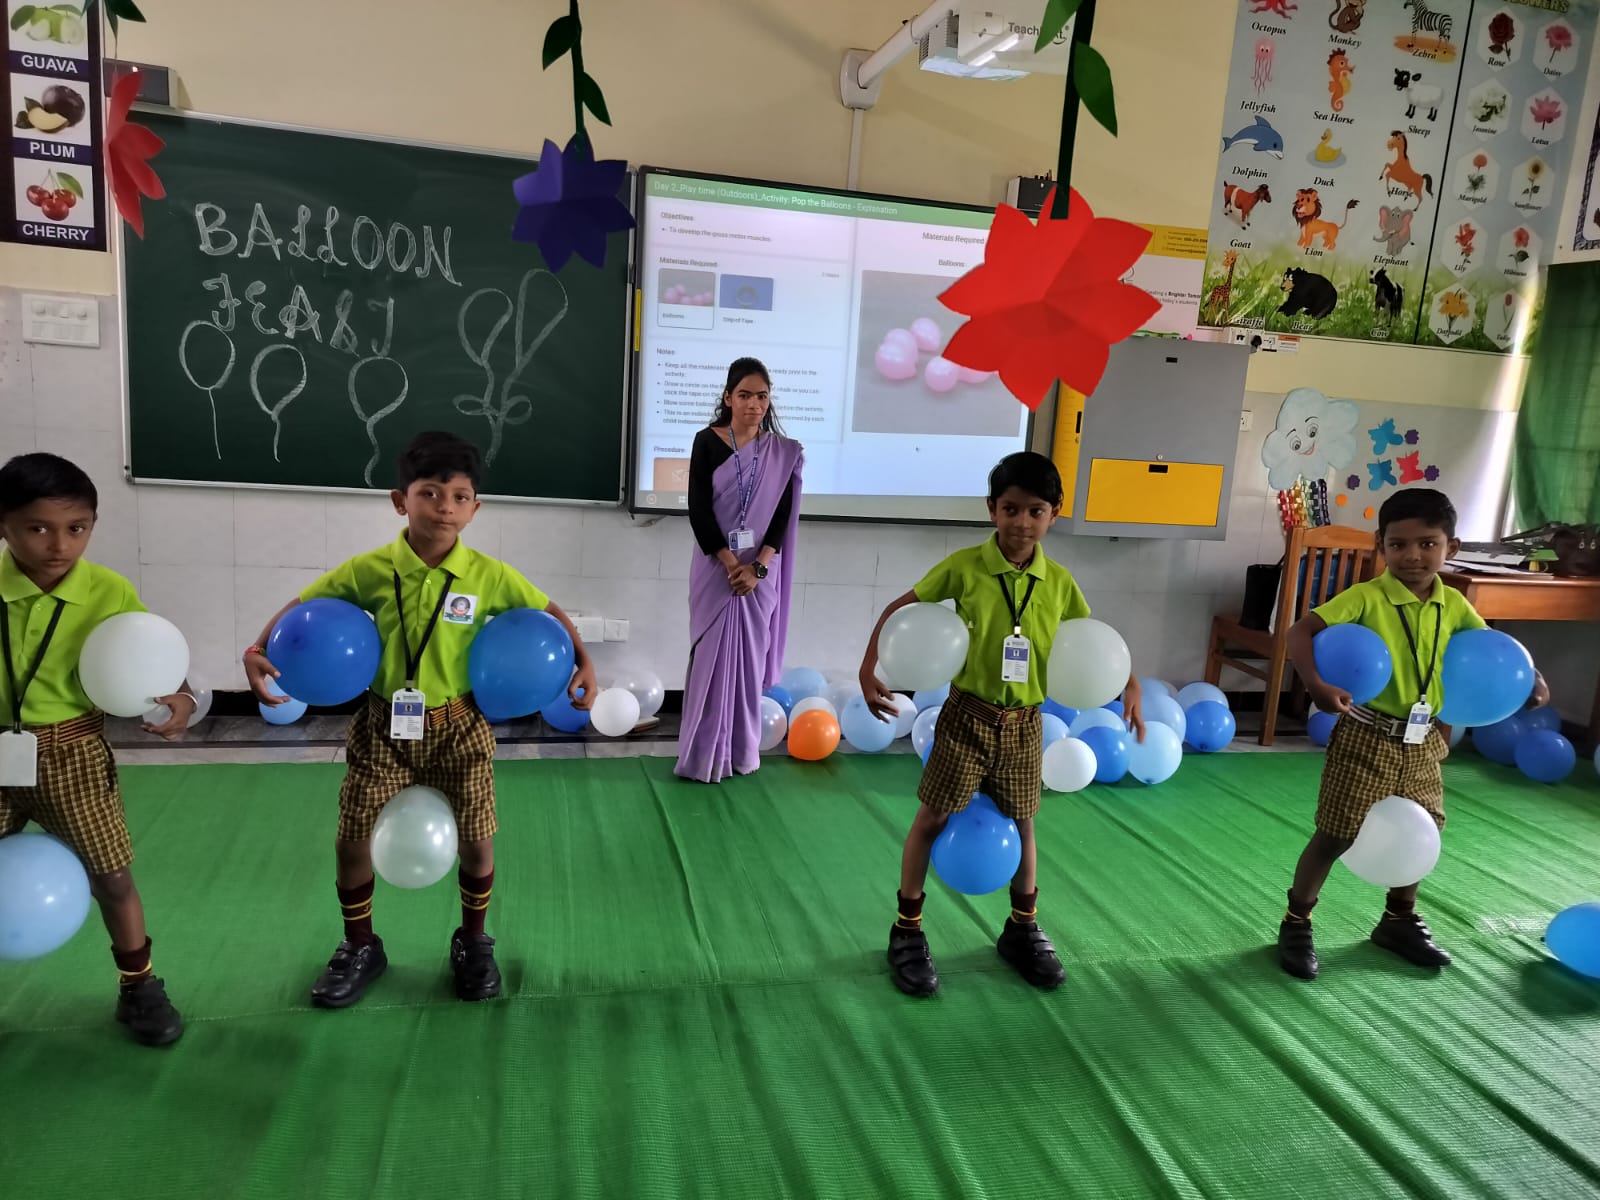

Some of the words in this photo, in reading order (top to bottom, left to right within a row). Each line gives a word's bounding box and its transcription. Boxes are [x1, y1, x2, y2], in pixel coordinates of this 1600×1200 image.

[1251, 22, 1287, 36] Octopus
[1328, 34, 1362, 48] Monkey
[1412, 48, 1437, 60] Zebra
[21, 54, 78, 74] GUAVA
[1488, 57, 1506, 67] Rose
[1240, 100, 1277, 114] Jellyfish
[1313, 110, 1328, 121] Sea
[1330, 113, 1355, 125] Horse
[1407, 125, 1431, 138] Sheep
[1472, 125, 1497, 135] Jasmine
[1531, 137, 1550, 146] Lotus
[29, 141, 75, 159] PLUM
[1232, 166, 1268, 179] Dolphin
[1313, 176, 1335, 187] Duck
[654, 181, 670, 192] Day
[700, 186, 716, 195] time
[791, 197, 805, 206] Pop
[808, 197, 820, 207] the
[820, 200, 852, 210] Balloons
[857, 203, 898, 214] Explanation
[1391, 187, 1414, 198] Horse
[1458, 194, 1488, 204] Marigold
[22, 223, 90, 241] CHERRY
[922, 232, 954, 241] Materials
[955, 235, 985, 244] Required
[195, 202, 463, 287] BALLOON
[1230, 239, 1251, 249] Goat
[1304, 247, 1323, 256] Lion
[938, 259, 965, 267] Balloons
[1373, 255, 1409, 267] Elephant
[1454, 264, 1466, 272] Lily
[1292, 320, 1313, 331] Bear
[1370, 328, 1389, 337] Cow
